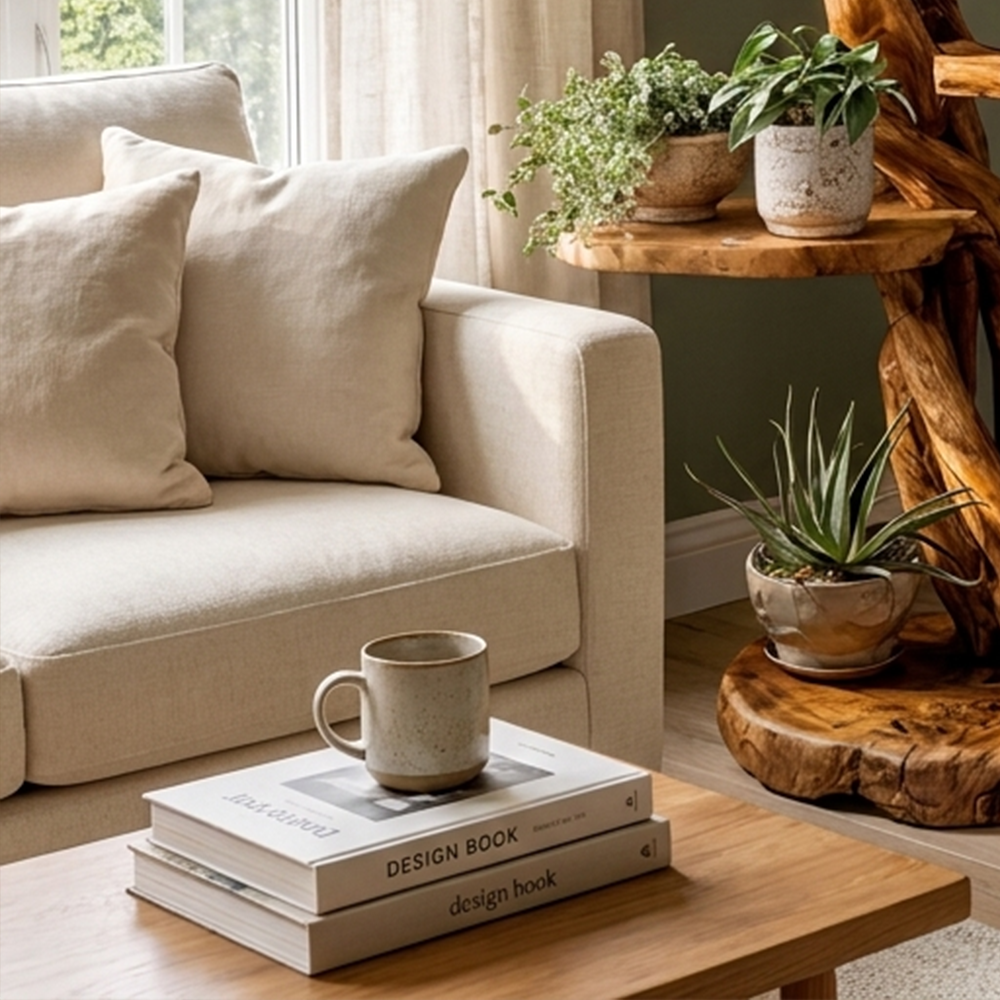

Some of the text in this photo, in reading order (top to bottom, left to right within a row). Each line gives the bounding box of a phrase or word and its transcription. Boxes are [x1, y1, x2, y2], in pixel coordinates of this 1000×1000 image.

[387, 827, 518, 878] DESIGN BOOK
[449, 886, 509, 916] design
